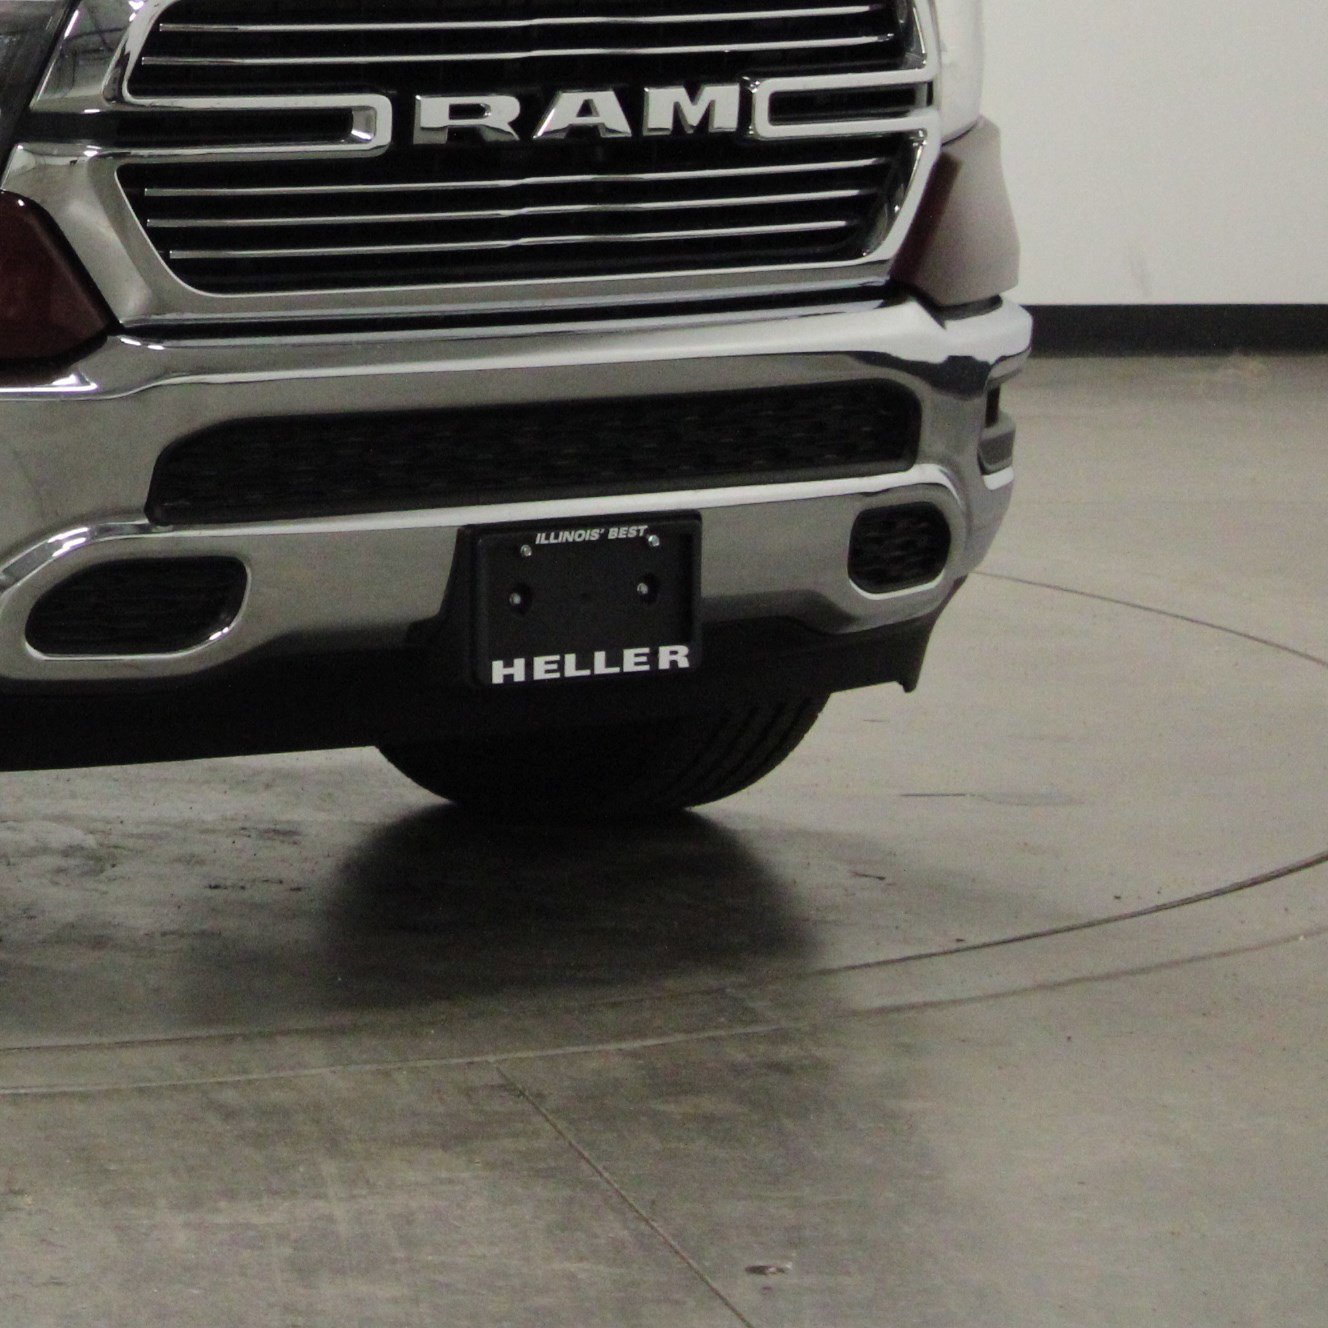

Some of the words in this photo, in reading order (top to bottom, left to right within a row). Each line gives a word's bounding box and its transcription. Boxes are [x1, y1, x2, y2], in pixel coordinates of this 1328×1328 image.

[412, 83, 741, 144] RAM
[607, 525, 648, 540] BEST
[491, 645, 690, 684] HELLER
